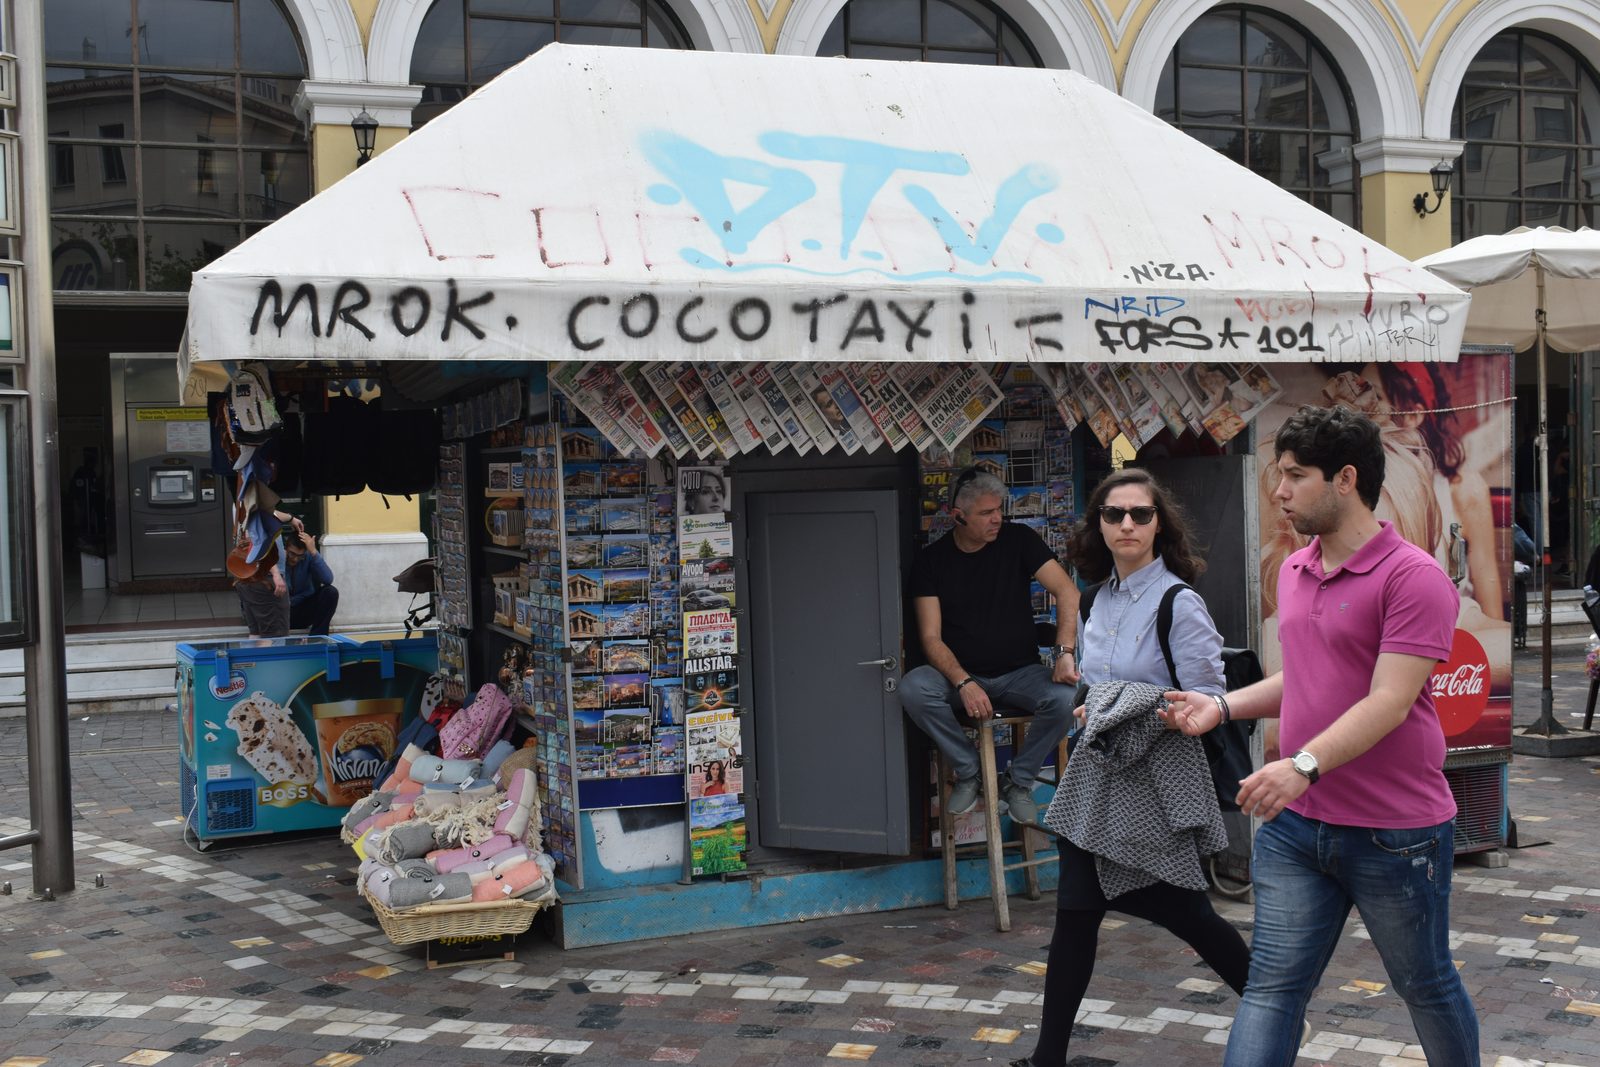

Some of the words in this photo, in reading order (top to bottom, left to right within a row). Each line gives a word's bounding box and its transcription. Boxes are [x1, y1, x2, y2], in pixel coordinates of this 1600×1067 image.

[1256, 320, 1325, 354] 101
[1431, 663, 1487, 698] ca-Cola
[688, 758, 744, 775] InSyle
[261, 783, 309, 803] BOSS
